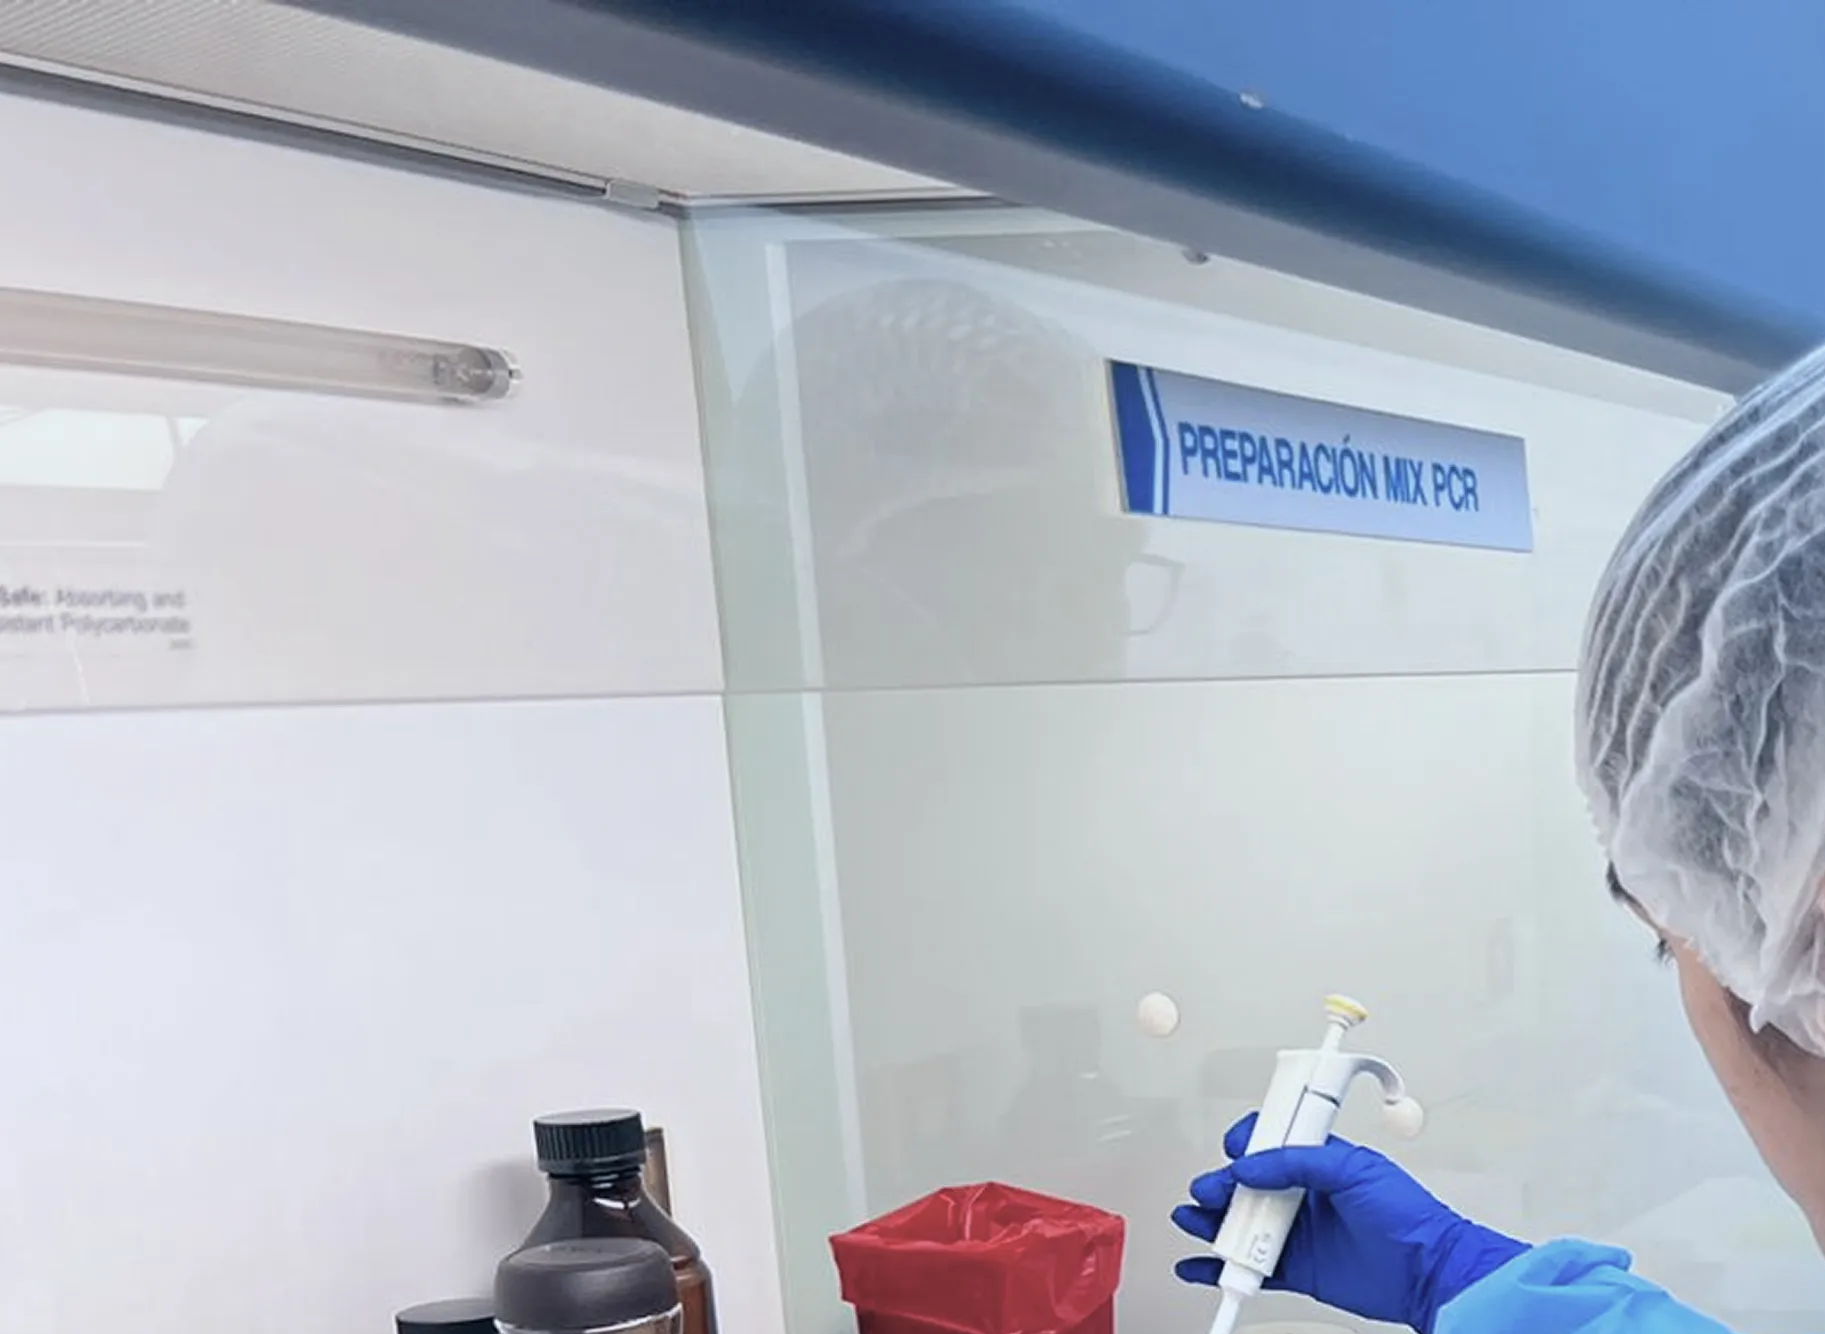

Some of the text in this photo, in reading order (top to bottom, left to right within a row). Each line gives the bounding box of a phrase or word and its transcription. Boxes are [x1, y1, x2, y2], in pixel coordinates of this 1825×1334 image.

[1178, 421, 1480, 512] PREPARACIÓN MIX PCR
[153, 591, 186, 608] and
